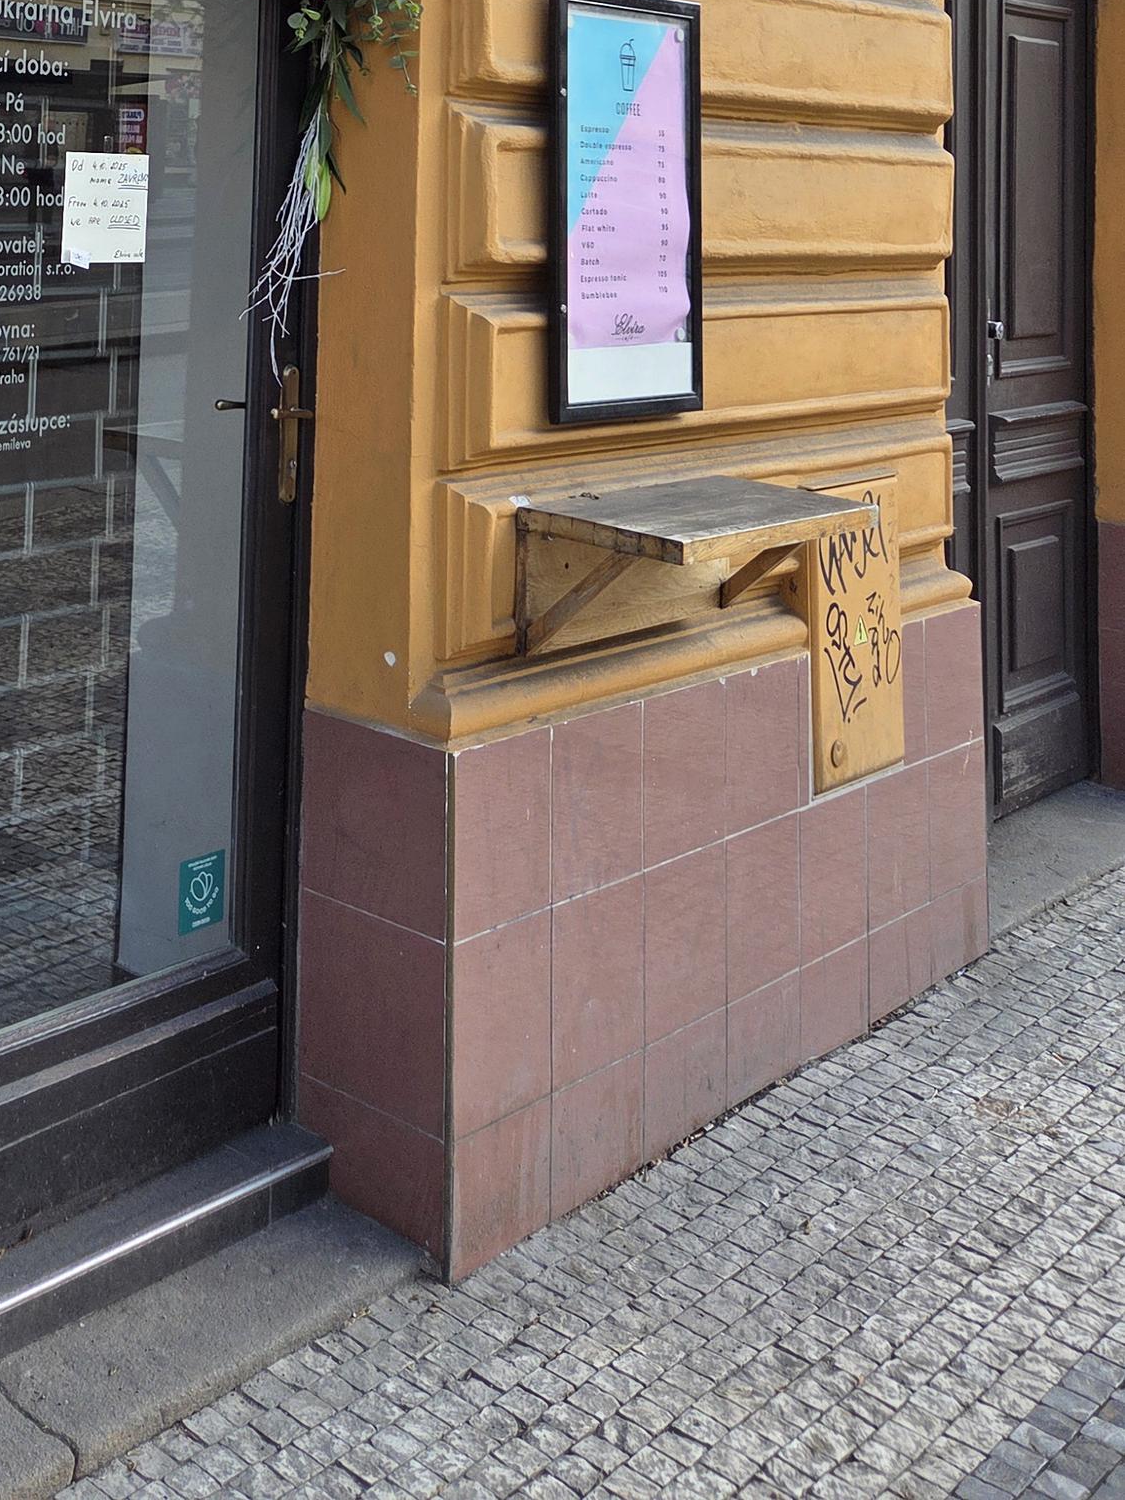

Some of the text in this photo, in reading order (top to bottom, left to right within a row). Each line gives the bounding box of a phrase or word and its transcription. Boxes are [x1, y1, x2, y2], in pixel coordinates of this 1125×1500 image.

[82, 0, 137, 30] Elvira
[15, 50, 68, 77] doba:
[5, 92, 24, 112] Pá
[616, 102, 641, 116] COFFEE
[37, 124, 66, 145] hod
[580, 125, 610, 134] Espresso
[580, 140, 603, 149] Double
[605, 143, 632, 151] espresso
[2, 154, 25, 175] Ne
[580, 158, 614, 166] Americano
[580, 173, 618, 183] Cappuccino
[36, 186, 64, 206] hod
[580, 191, 598, 199] Latte
[581, 207, 608, 215] Cortado
[581, 224, 595, 232] Flat
[597, 224, 616, 232] white
[580, 258, 600, 266] Batch
[46, 263, 75, 276] s.r.o.
[580, 275, 609, 283] Espresso
[581, 291, 618, 299] Bumblebee
[2, 345, 40, 363] 761/21
